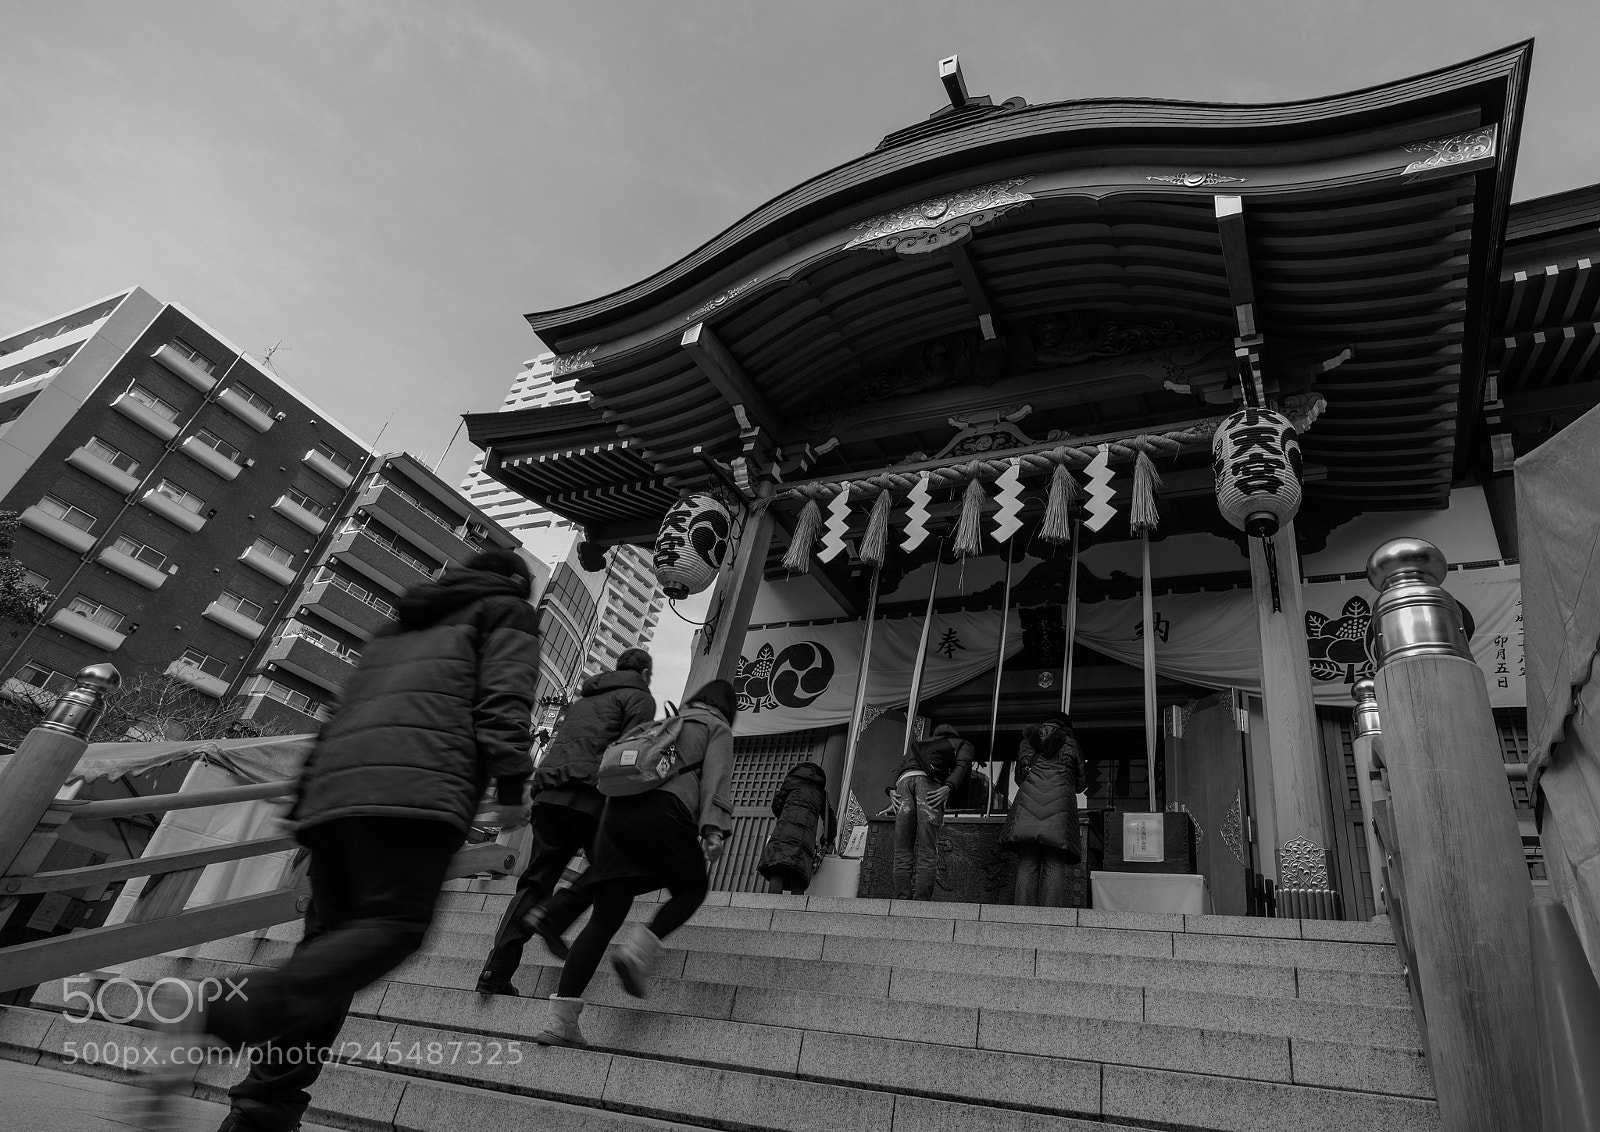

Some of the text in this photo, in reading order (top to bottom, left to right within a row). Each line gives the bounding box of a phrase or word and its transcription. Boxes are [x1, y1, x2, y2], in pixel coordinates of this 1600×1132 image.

[1224, 408, 1286, 496] 水天宮
[934, 627, 967, 659] 奉
[1494, 634, 1511, 689] 卯月五日
